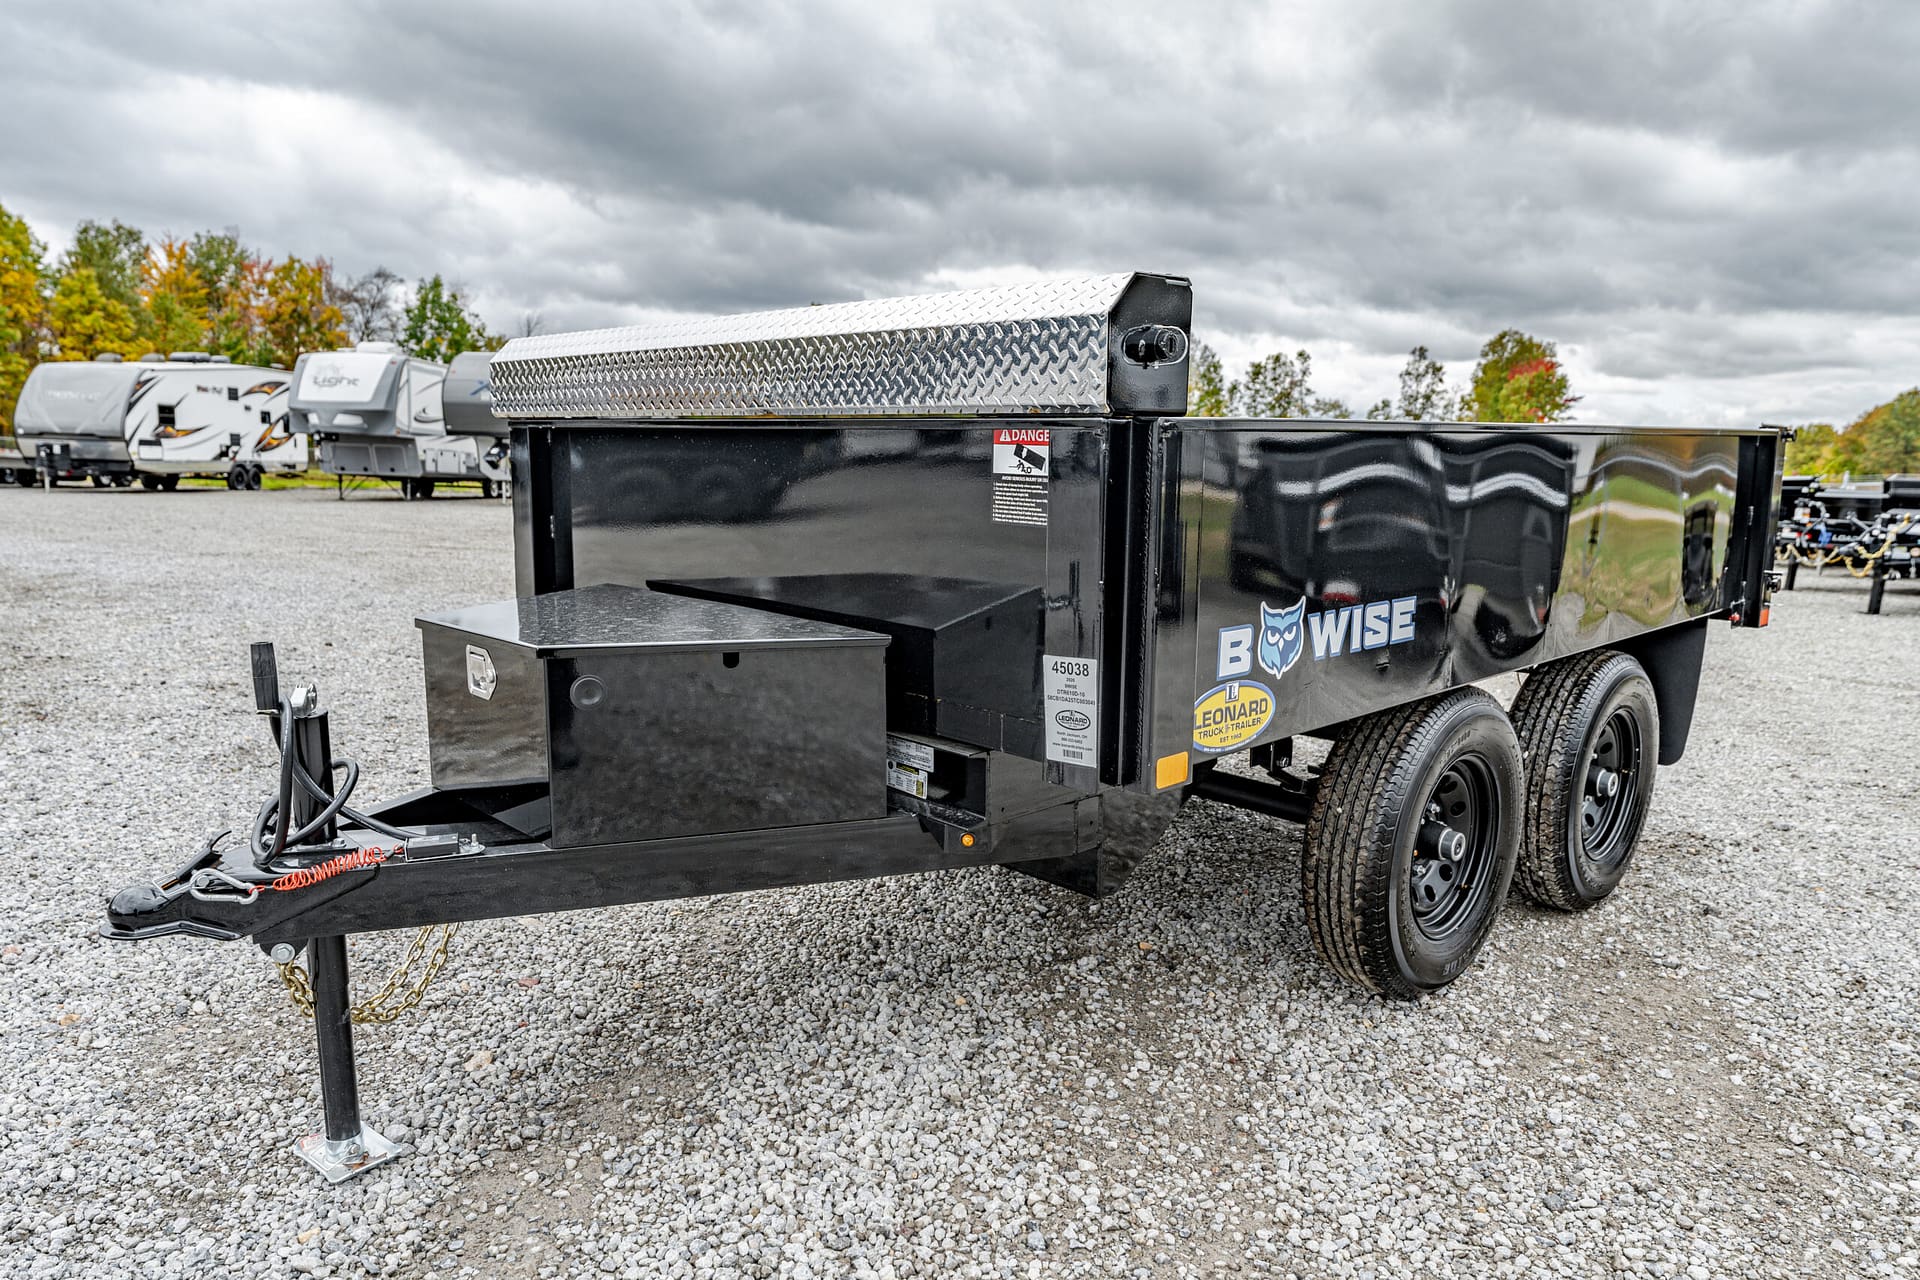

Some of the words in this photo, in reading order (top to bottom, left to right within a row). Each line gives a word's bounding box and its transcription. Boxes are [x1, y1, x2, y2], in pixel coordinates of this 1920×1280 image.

[1012, 429, 1050, 442] DANGE
[1051, 660, 1090, 677] 45038
[1058, 715, 1088, 725] LEONARD
[1194, 697, 1268, 730] LEONARD
[1198, 726, 1225, 740] TRUCK
[1229, 717, 1262, 732] TRAILER
